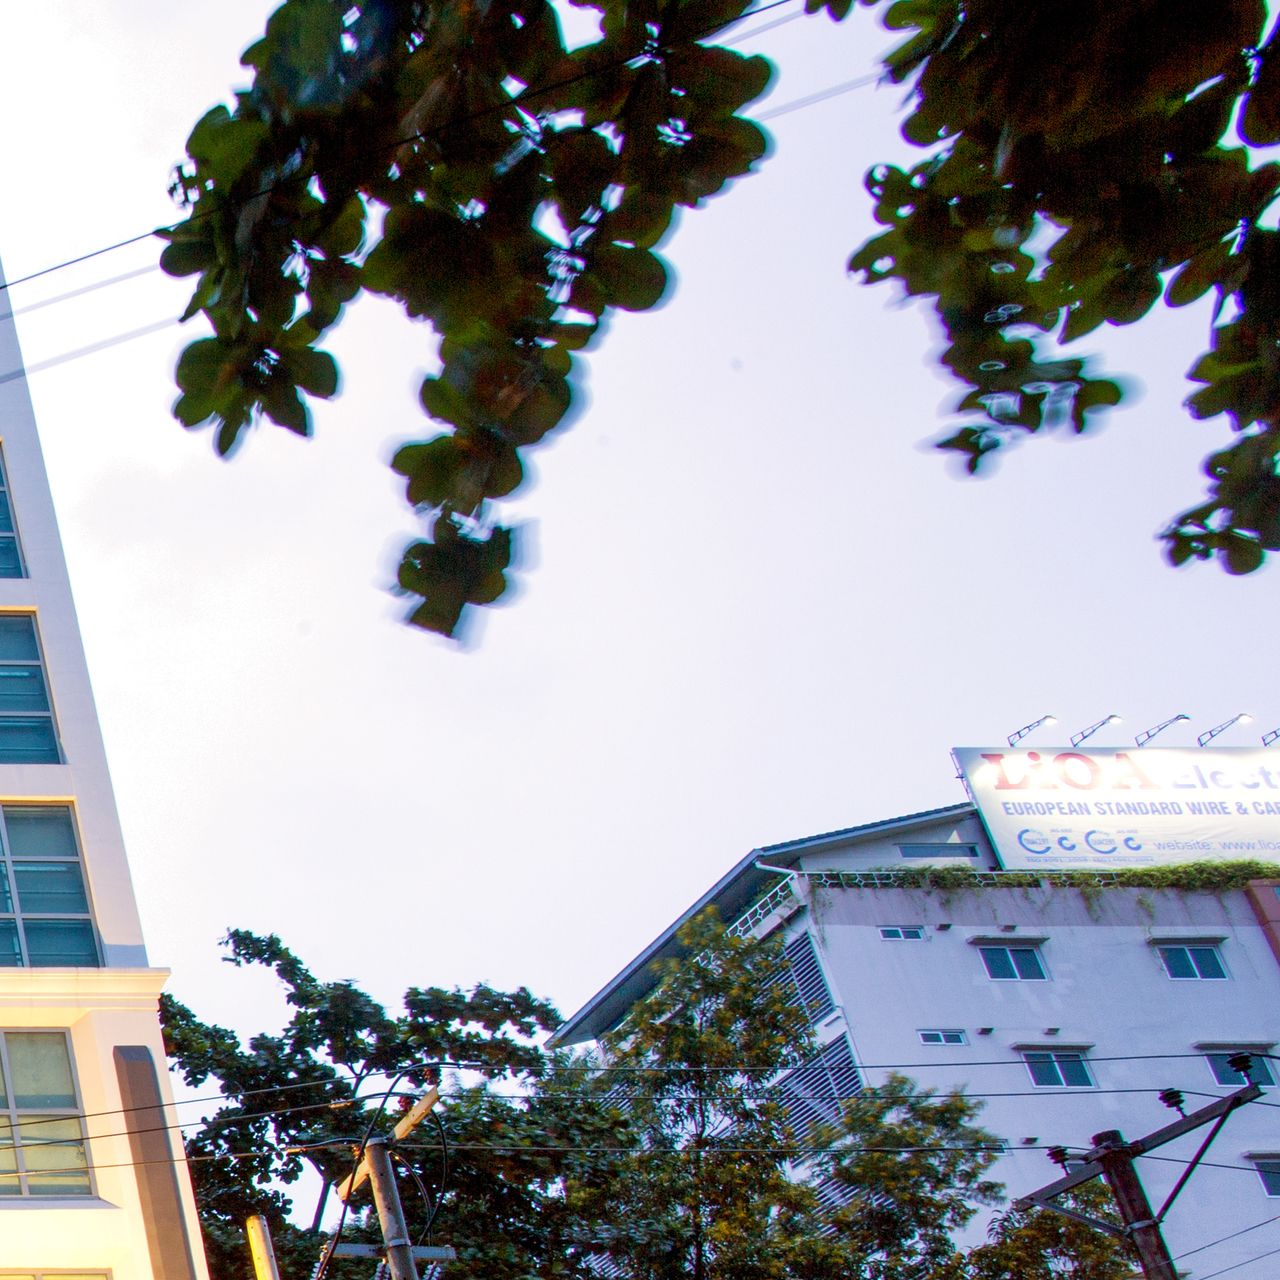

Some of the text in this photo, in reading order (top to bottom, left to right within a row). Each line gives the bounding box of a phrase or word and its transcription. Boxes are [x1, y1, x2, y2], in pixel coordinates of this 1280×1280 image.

[1002, 801, 1092, 816] EUROPEAN
[1097, 801, 1184, 815] STANDARD
[1185, 801, 1233, 815] WIRE
[1236, 801, 1250, 815] &
